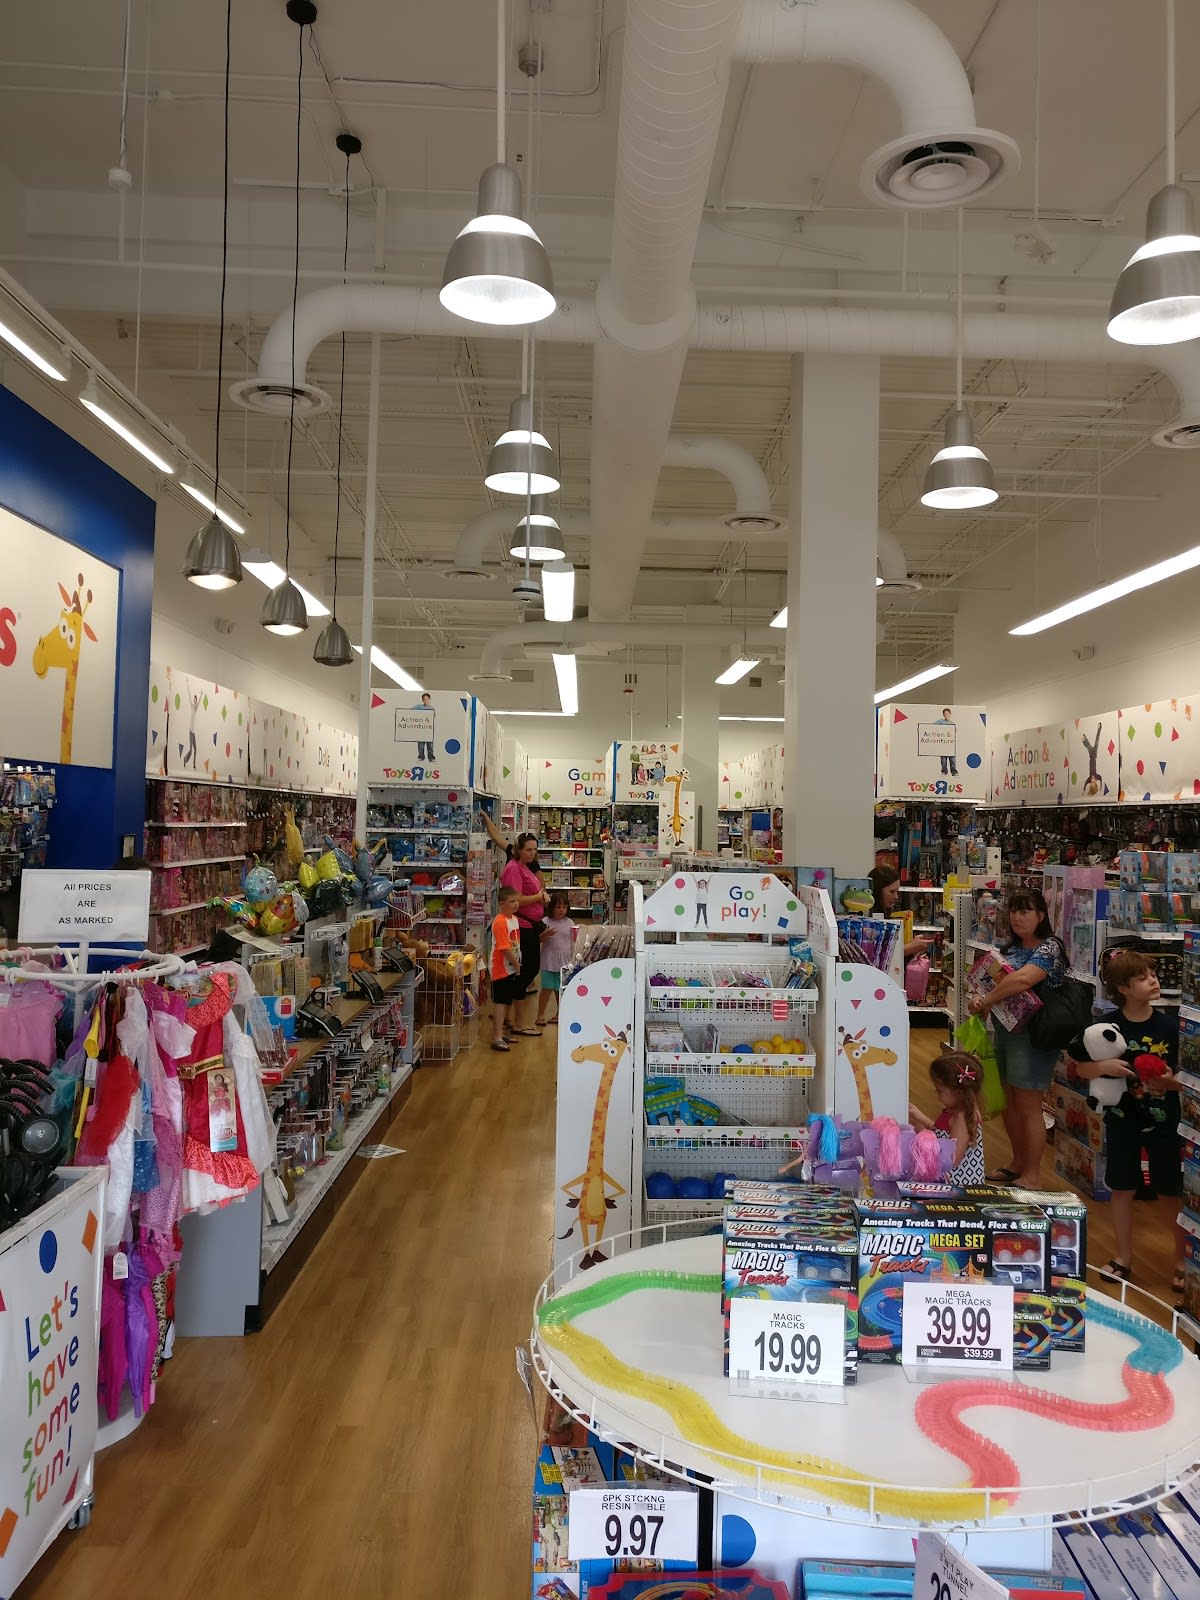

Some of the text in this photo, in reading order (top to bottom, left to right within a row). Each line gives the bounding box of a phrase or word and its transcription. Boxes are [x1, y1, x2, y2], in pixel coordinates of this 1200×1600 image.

[923, 730, 946, 738] Action
[1007, 741, 1050, 768] Action &
[568, 768, 606, 782] Gam
[1003, 770, 1056, 791] Adventure
[574, 783, 606, 797] Puz
[64, 883, 112, 891] All PRICES
[729, 885, 755, 901] Go
[77, 900, 97, 908] ARE
[721, 903, 767, 922] play!
[74, 917, 114, 925] MARKED
[903, 1182, 953, 1192] MAGIC
[860, 1200, 912, 1209] MAGIC
[926, 1204, 955, 1212] MEGA
[1046, 1207, 1083, 1217] & Glow!
[862, 1217, 1047, 1230] Amazing Tracks That Bend, Flex & Glow!
[727, 1239, 755, 1249] Amazing
[795, 1244, 814, 1252] Bend,
[862, 1232, 925, 1257] MAGIC
[929, 1232, 985, 1248] MEGA SET
[732, 1250, 787, 1273] MAGIC
[868, 1255, 929, 1278] Tracks
[737, 1268, 790, 1289] Tracks
[925, 1296, 992, 1306] MAGIC TRACKS
[945, 1290, 972, 1298] MEGA
[25, 1280, 79, 1362] Let's
[773, 1312, 802, 1322] MAGIC
[769, 1320, 805, 1330] TRACKS
[926, 1305, 991, 1347] 39.99
[754, 1330, 822, 1375] 19.99
[963, 1347, 994, 1359] $39.99
[28, 1335, 79, 1417] have
[22, 1382, 80, 1474] some
[24, 1425, 73, 1516] fun!
[602, 1494, 665, 1503] 6PK STCKNG
[601, 1503, 666, 1511] RESIN BLE
[604, 1514, 664, 1556] 9.97
[943, 1565, 969, 1598] TUNNEL
[956, 1568, 974, 1591] PLAY
